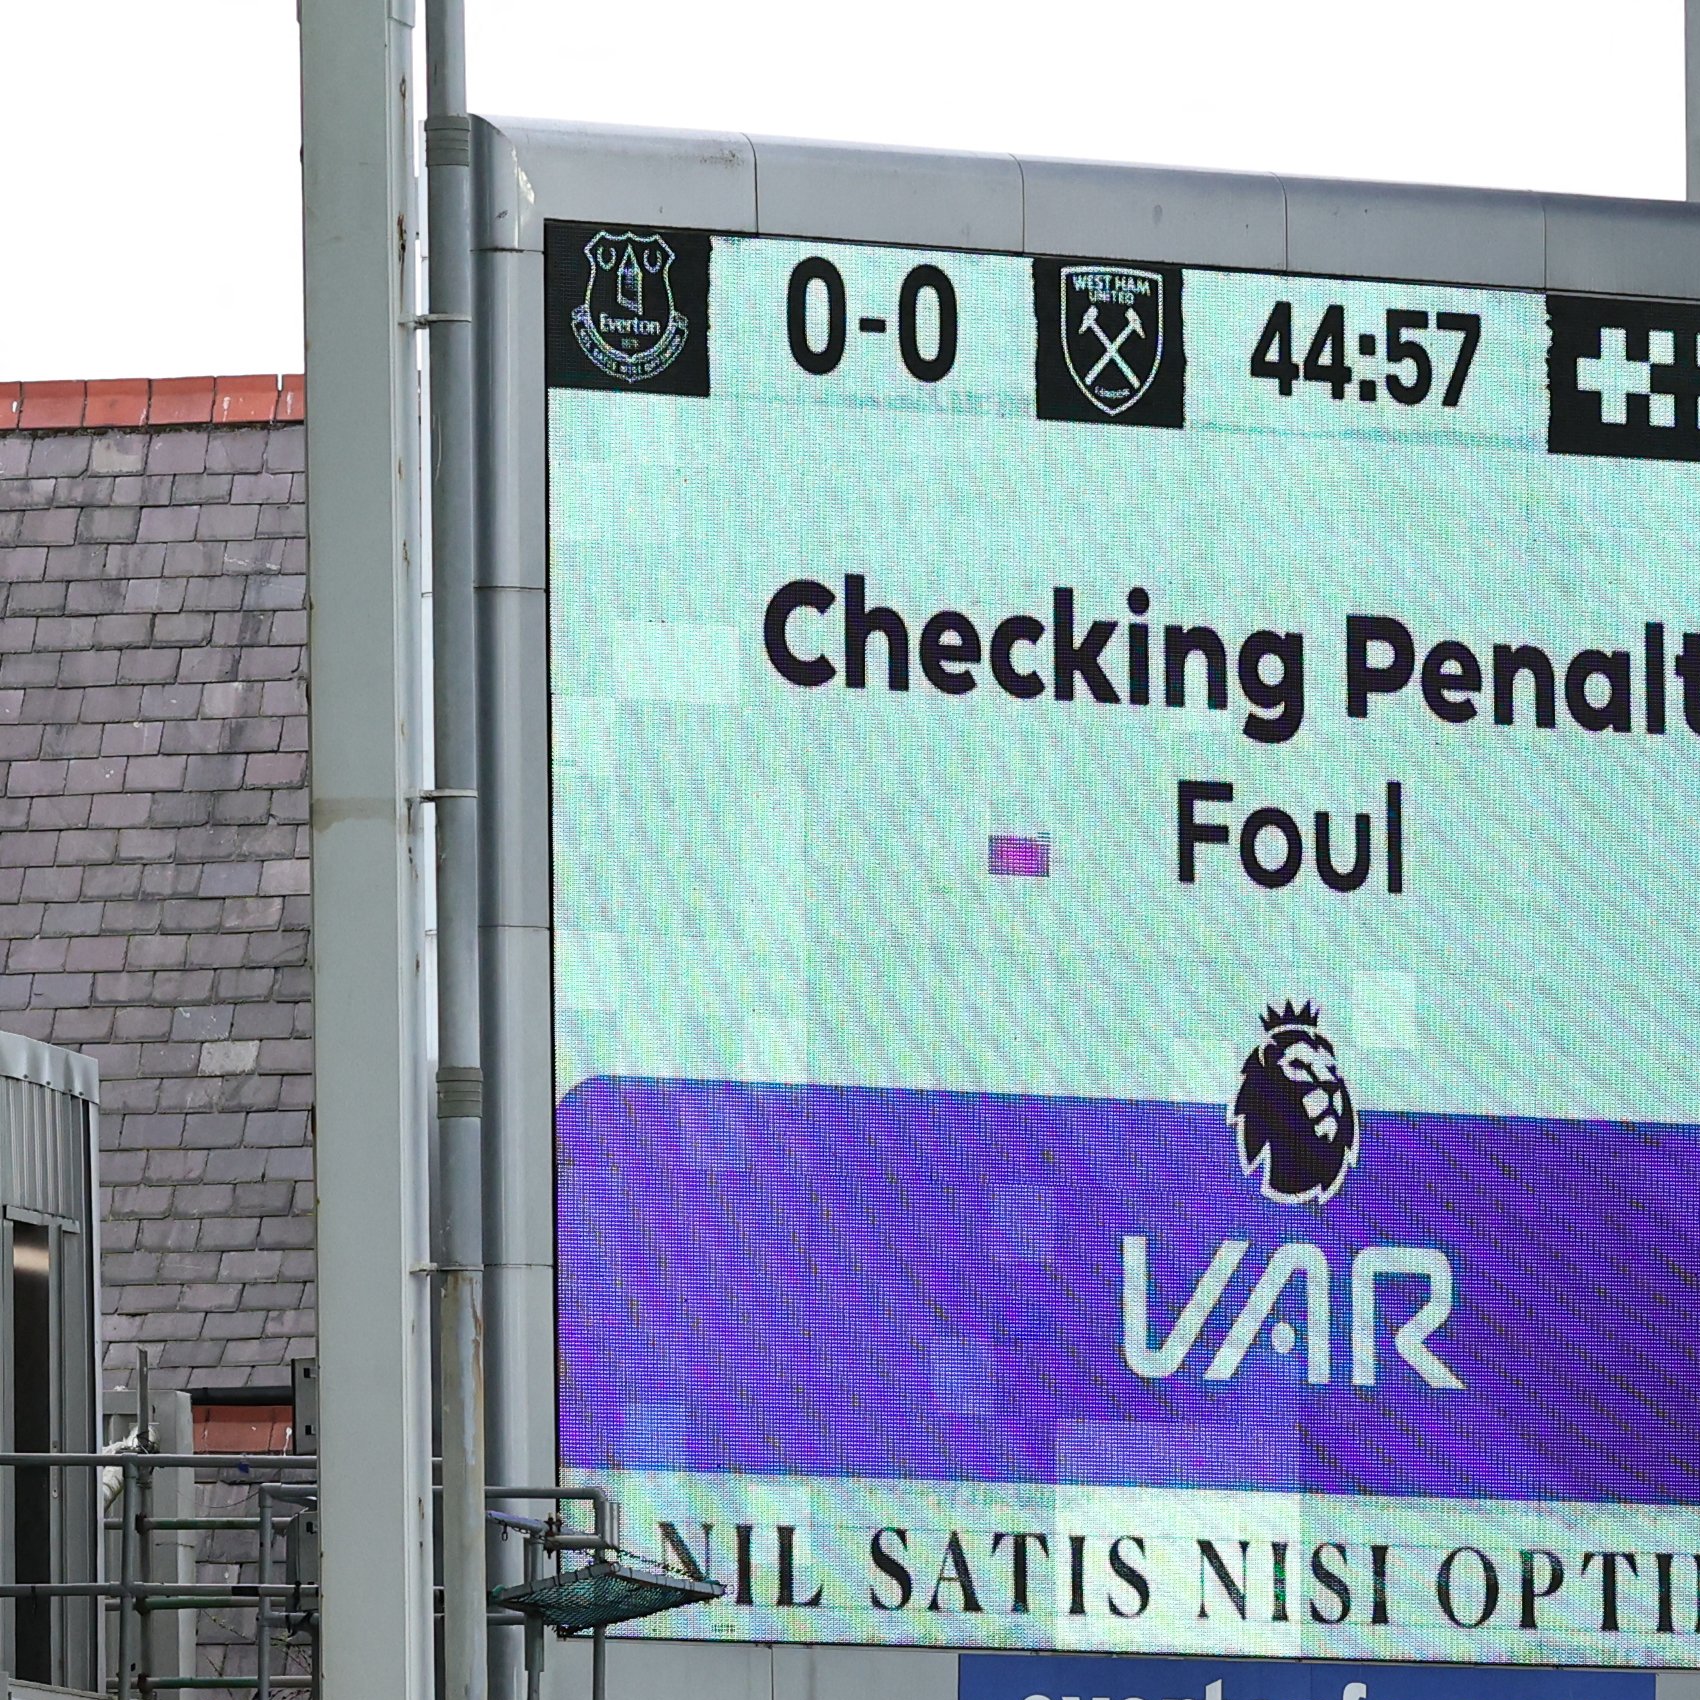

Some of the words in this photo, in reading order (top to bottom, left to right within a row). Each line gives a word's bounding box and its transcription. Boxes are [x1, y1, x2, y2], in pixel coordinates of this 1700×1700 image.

[787, 256, 957, 382] 0-0
[1072, 274, 1112, 291] WEST
[1115, 276, 1151, 297] HAM
[1250, 301, 1482, 407] 44:57
[763, 573, 1303, 744] Checking
[1177, 780, 1402, 894] Foul
[1121, 1235, 1467, 1390] VAR
[658, 1520, 823, 1608] NIL
[869, 1526, 1153, 1617] SATIS
[1197, 1537, 1391, 1626] NISI
